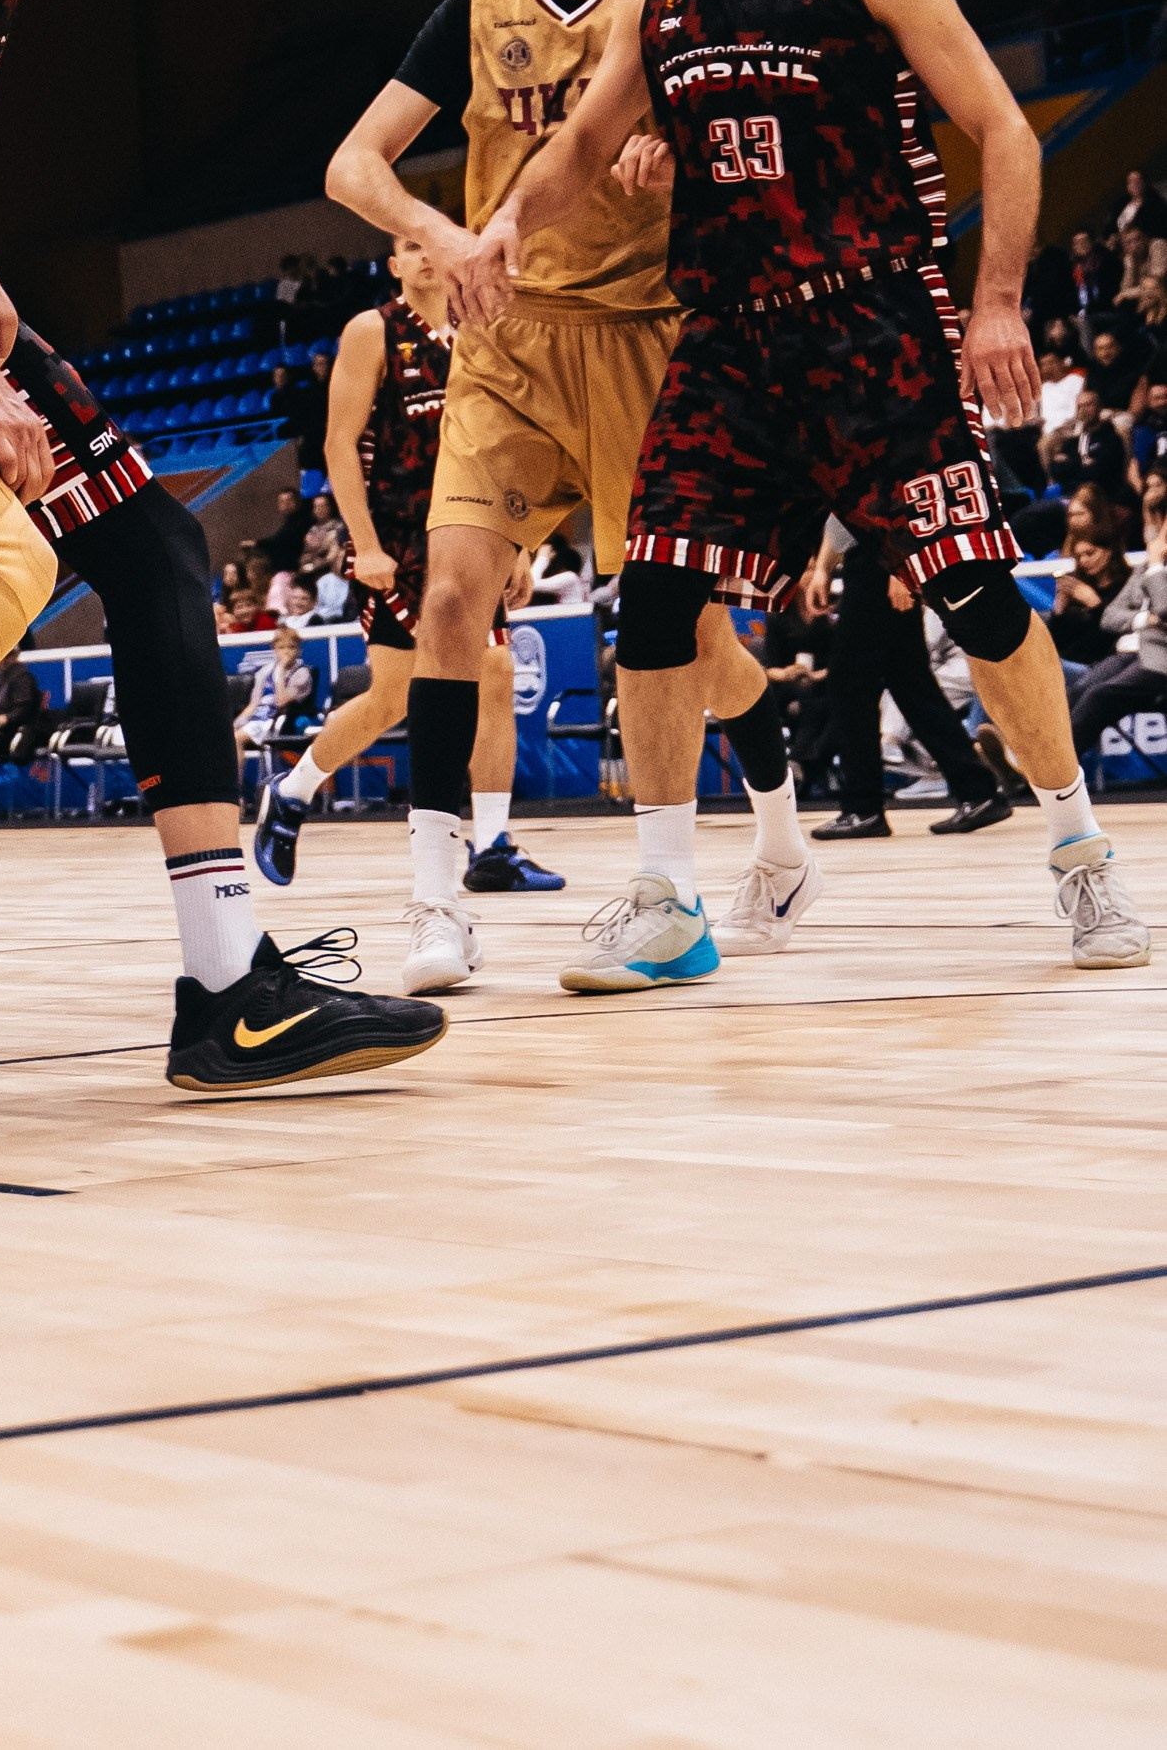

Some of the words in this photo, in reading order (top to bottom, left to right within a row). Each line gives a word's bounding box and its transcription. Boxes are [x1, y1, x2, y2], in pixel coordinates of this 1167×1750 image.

[708, 115, 785, 183] 33
[89, 426, 118, 457] STK
[903, 461, 990, 538] 33
